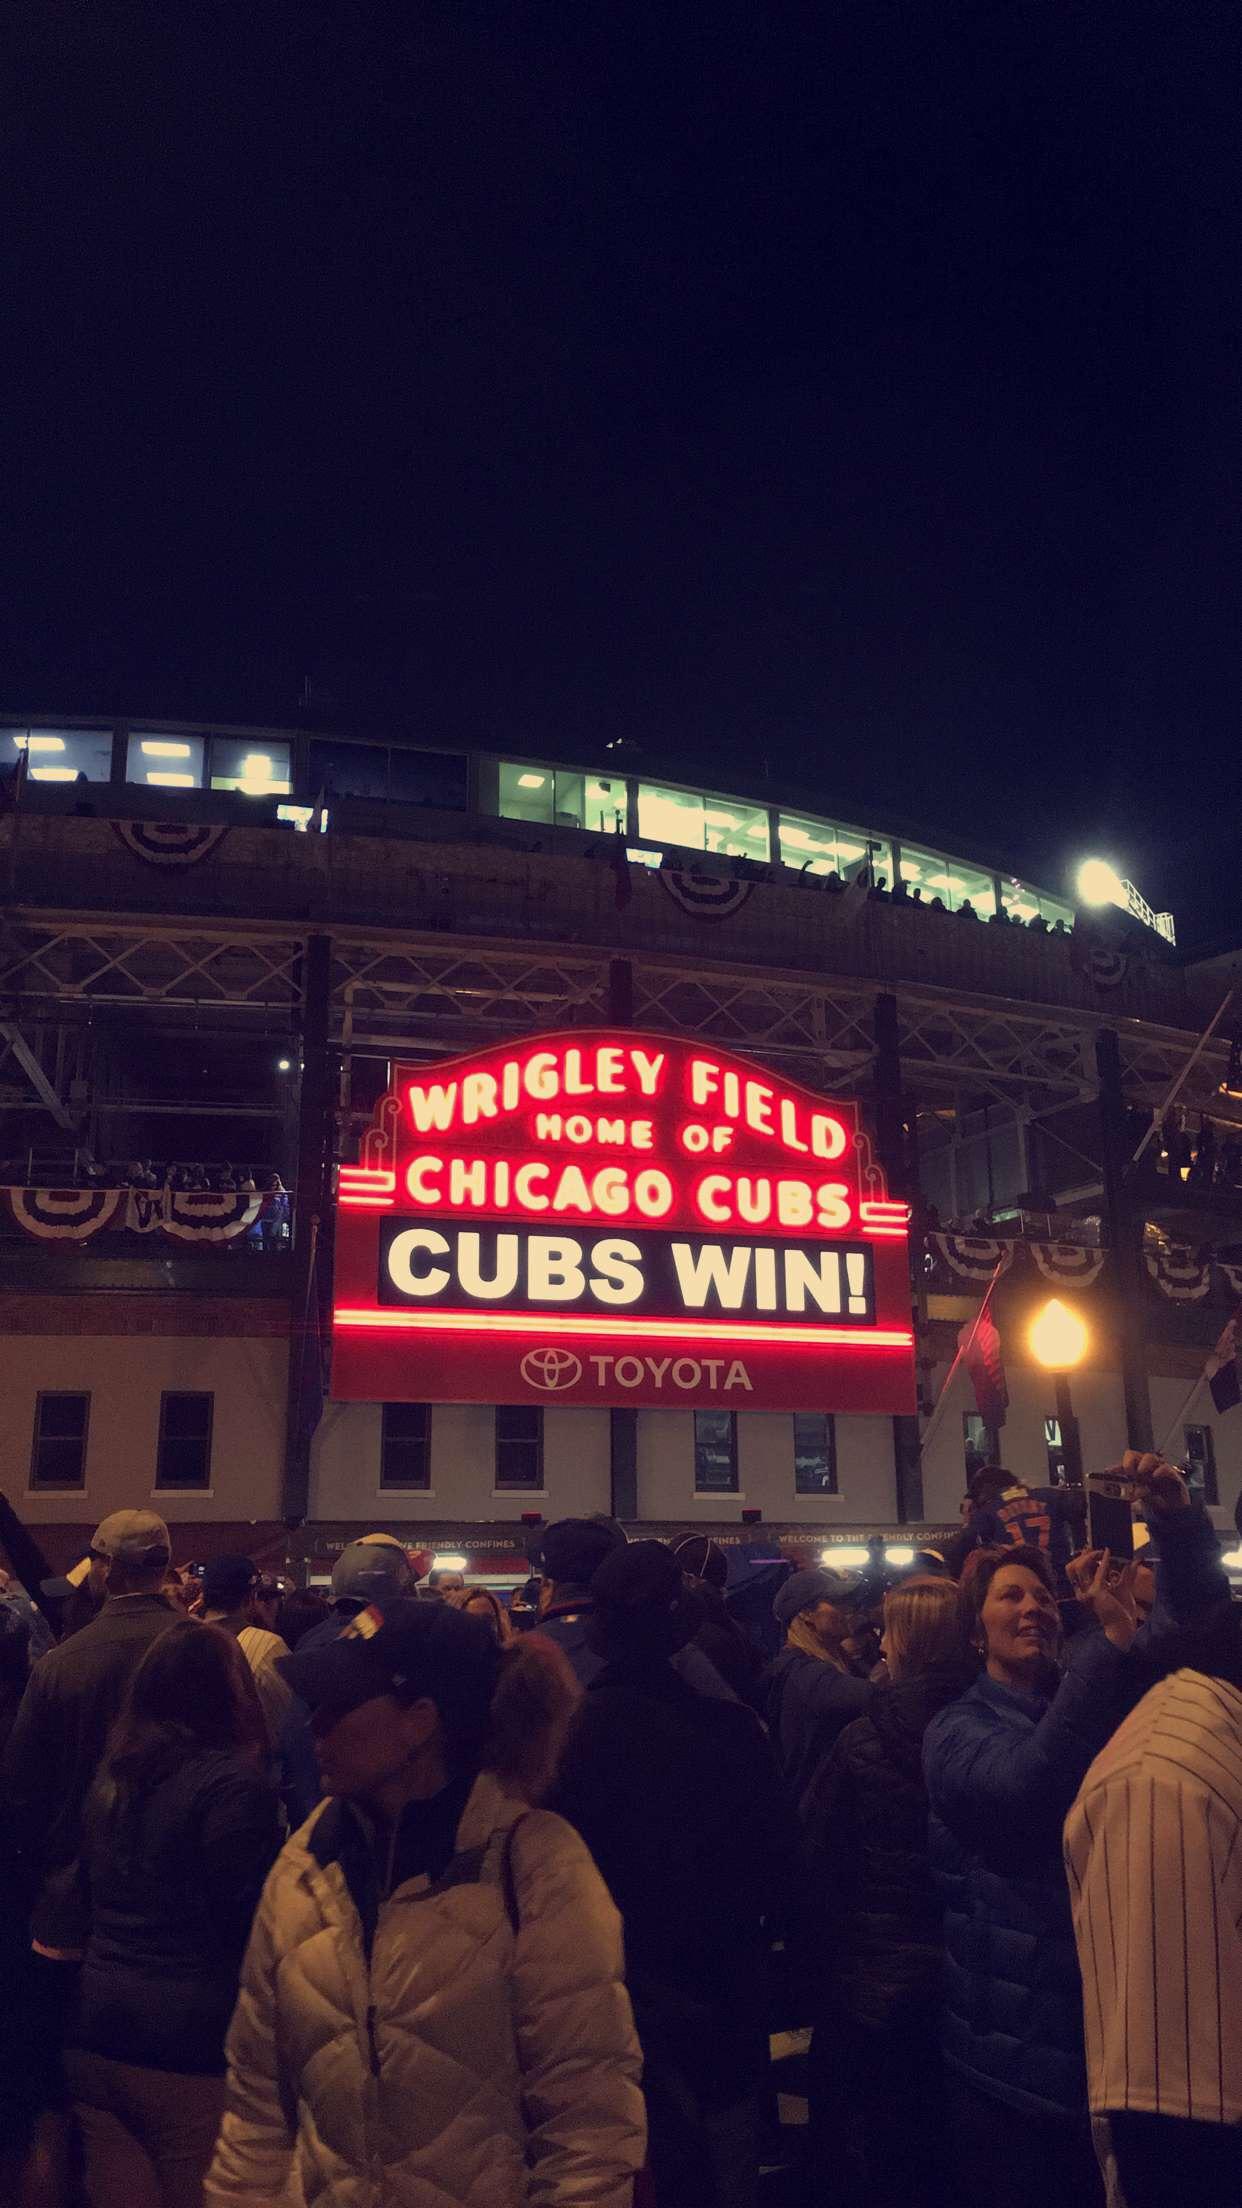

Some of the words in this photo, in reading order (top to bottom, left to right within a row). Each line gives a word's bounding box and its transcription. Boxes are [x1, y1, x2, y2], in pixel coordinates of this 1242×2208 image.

[408, 1047, 665, 1133] WRIGLEY
[691, 1060, 847, 1159] FIELD
[535, 1112, 653, 1149] HOME
[682, 1124, 734, 1153] OF
[406, 1156, 673, 1217] CHICAGO
[696, 1175, 852, 1228] CUBS
[387, 1227, 645, 1305] CUBS
[671, 1243, 867, 1315] WIN!
[589, 1353, 753, 1391] TOYOTA
[464, 1538, 516, 1549] CONFINES
[778, 1534, 828, 1544] WELCOME
[831, 1534, 844, 1543] TO
[847, 1534, 864, 1543] THE
[867, 1532, 914, 1542] FENDLY
